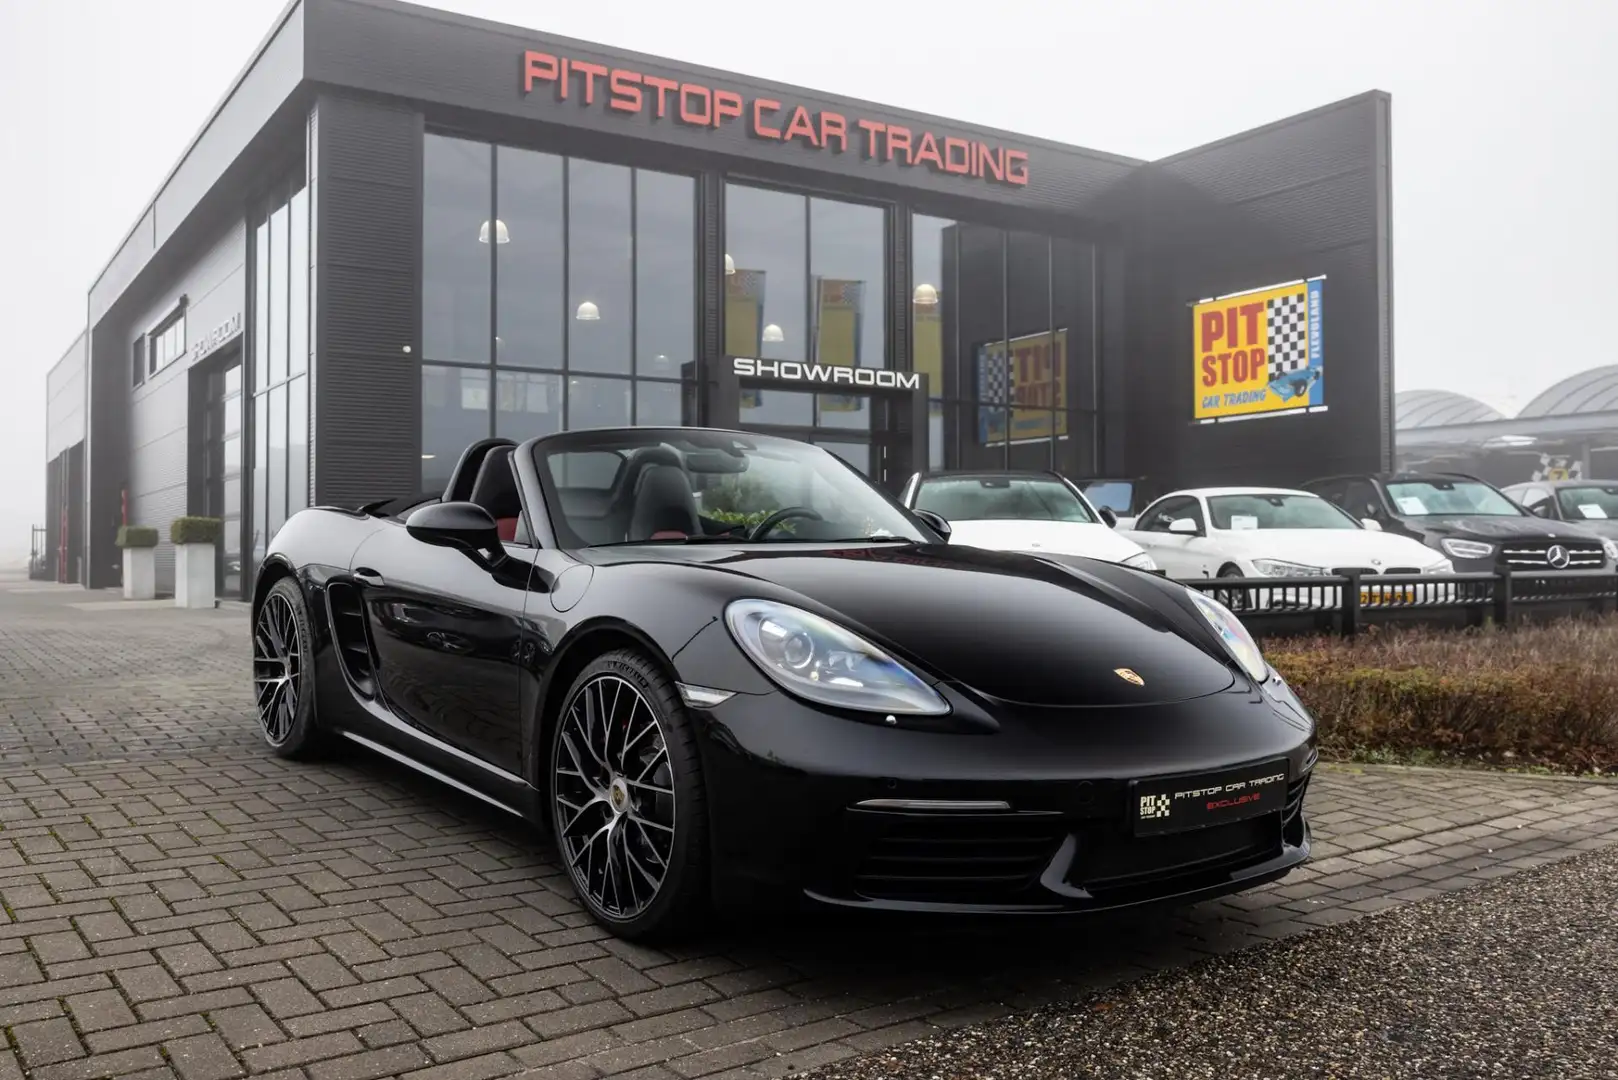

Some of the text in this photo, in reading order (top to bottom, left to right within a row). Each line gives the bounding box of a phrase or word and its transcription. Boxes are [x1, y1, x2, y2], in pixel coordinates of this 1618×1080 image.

[523, 50, 1029, 186] PITSTOP CAR TRADING
[1201, 302, 1264, 353] PIT
[733, 358, 920, 390] SHOWROOM
[1202, 348, 1265, 387] STOP
[1202, 389, 1266, 409] CAR TRADING
[1174, 786, 1222, 800] PITSTOP
[1225, 781, 1246, 792] CAR
[1140, 795, 1156, 807] PIT
[1140, 806, 1156, 816] STOP
[1206, 792, 1261, 810] EXCLUSIVE
